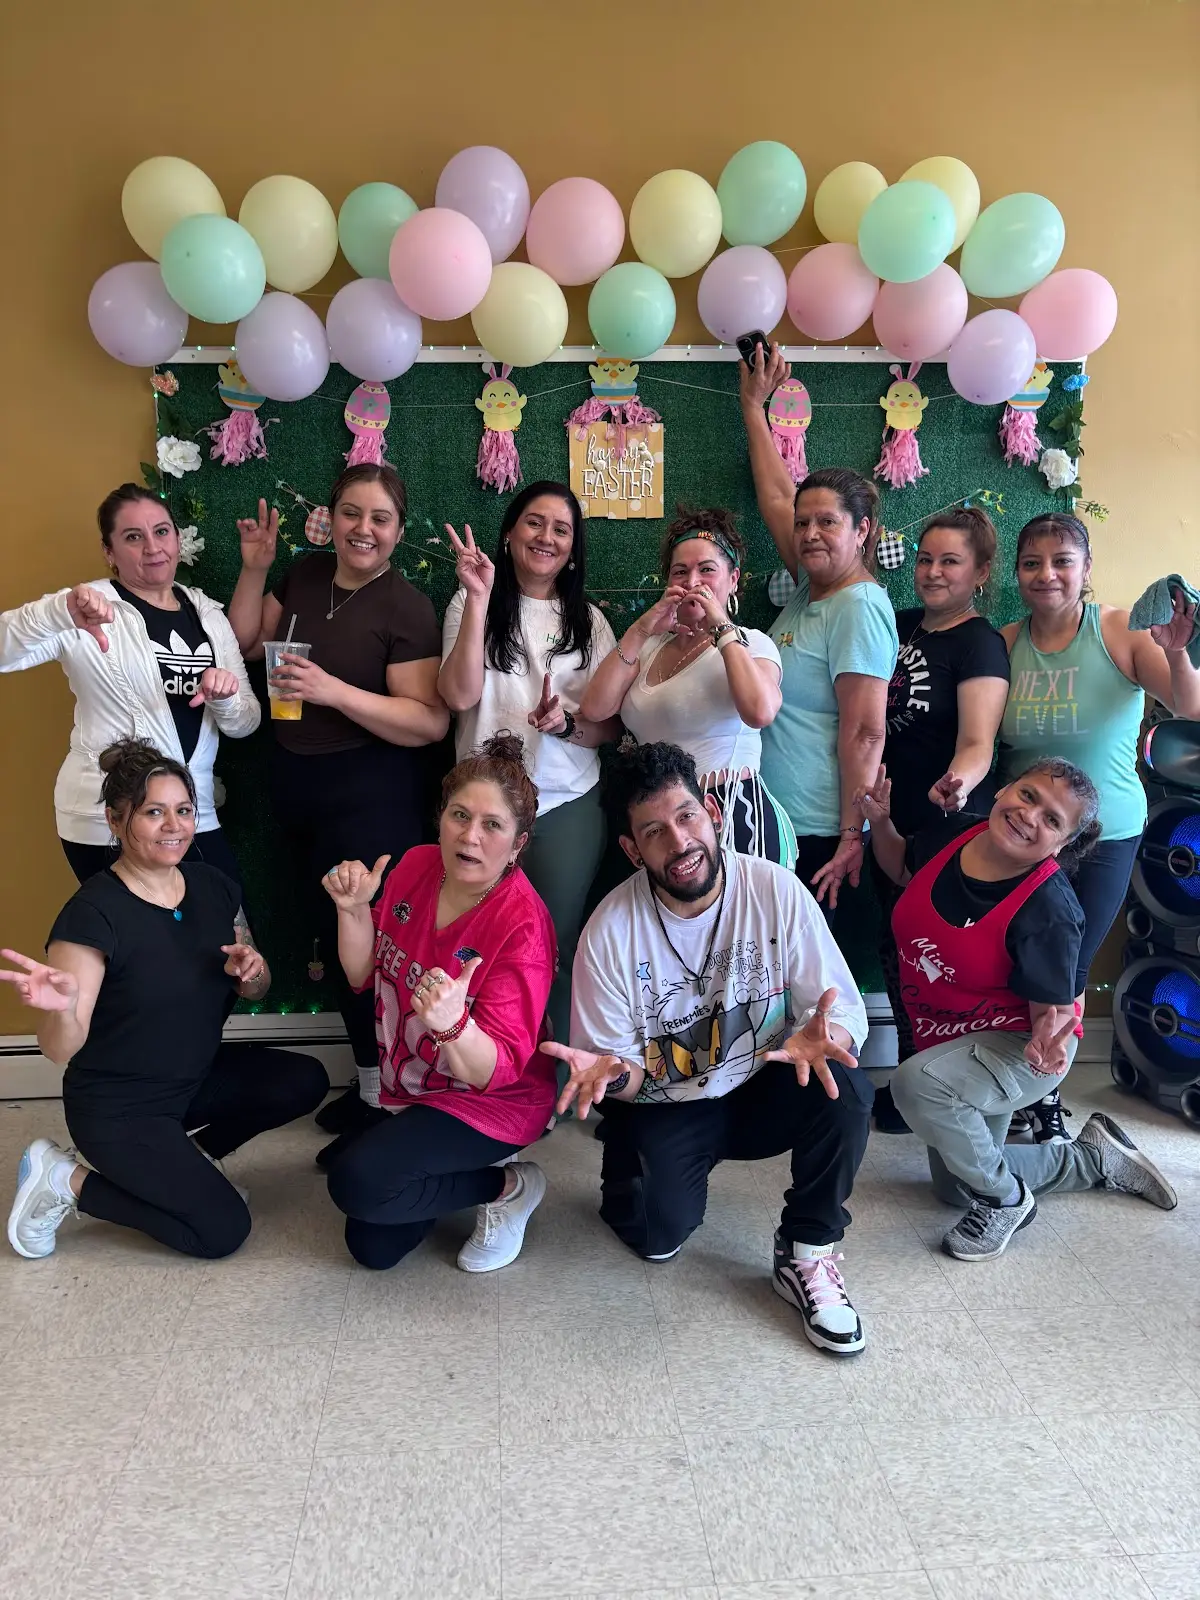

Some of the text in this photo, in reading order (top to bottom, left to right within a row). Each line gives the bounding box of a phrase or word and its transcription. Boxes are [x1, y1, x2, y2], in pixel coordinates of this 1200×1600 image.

[581, 466, 655, 500] EASTER
[1010, 666, 1079, 701] NEXT
[1012, 702, 1090, 736] EVEL
[915, 1015, 1026, 1038] Dance
